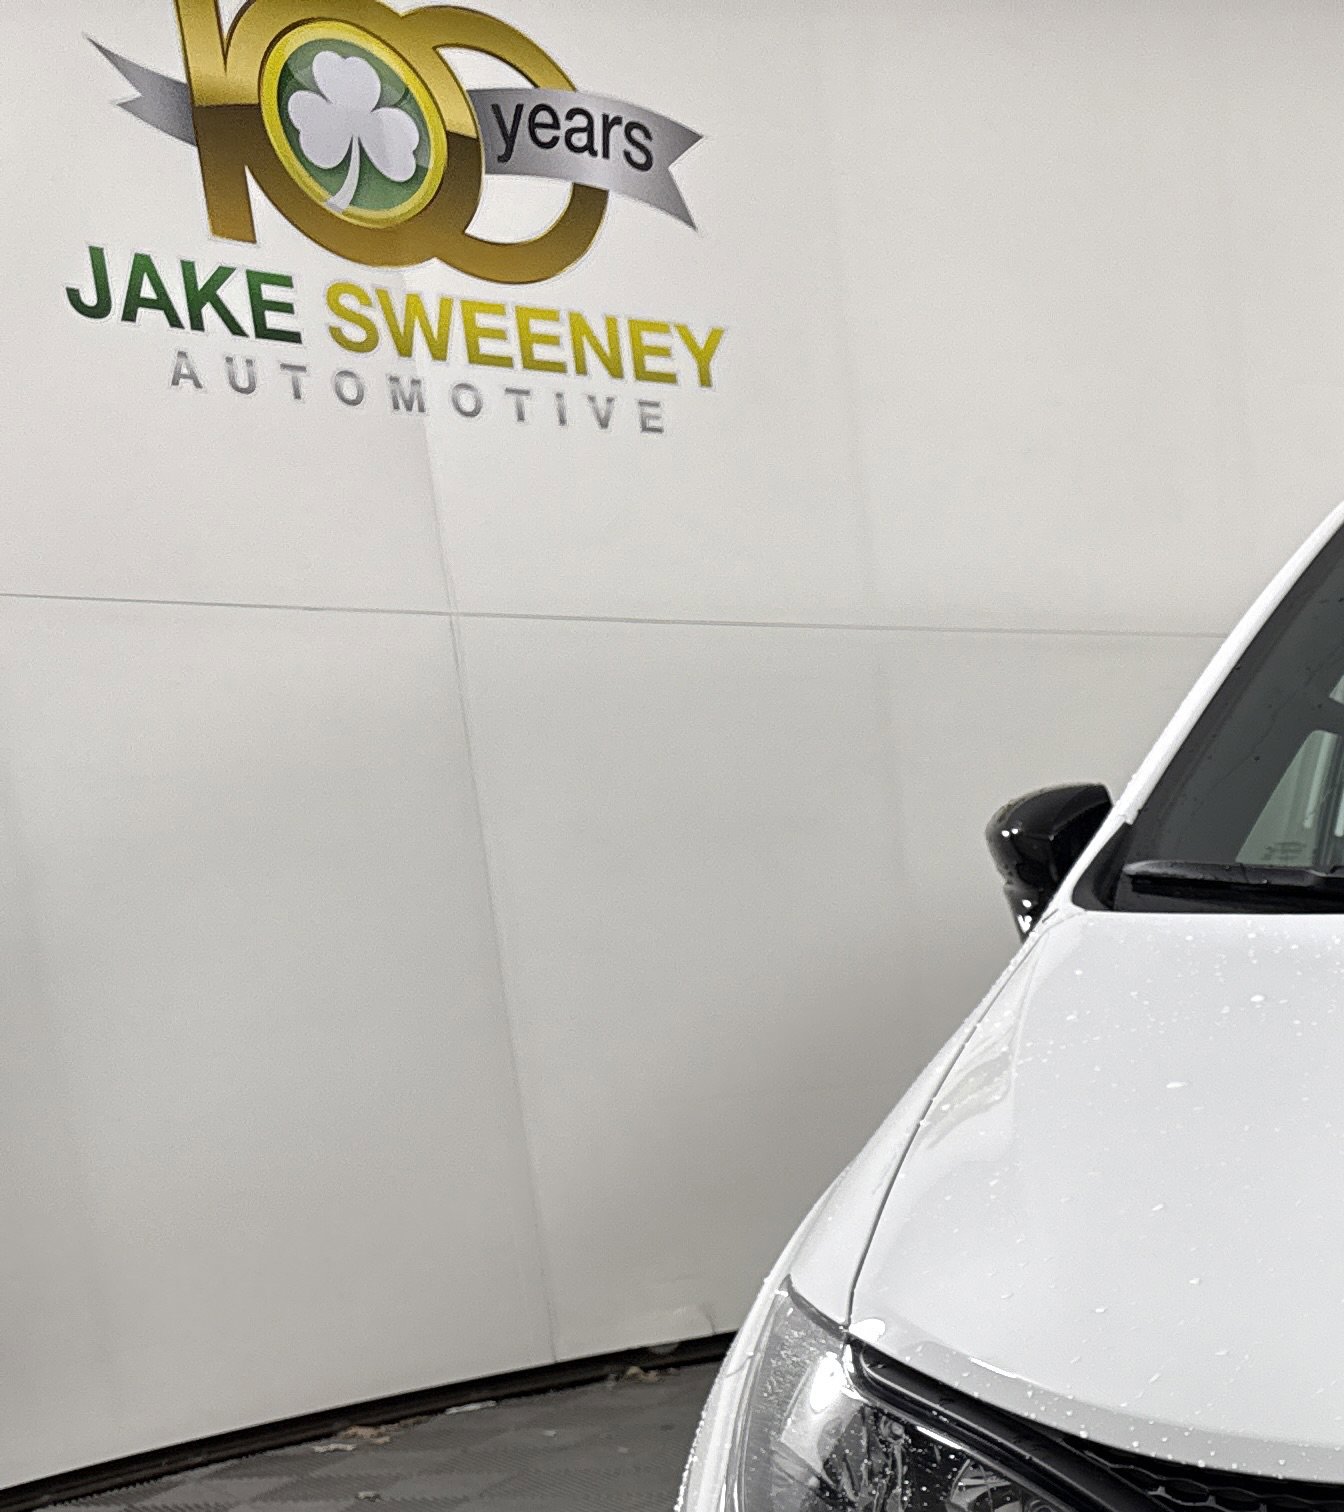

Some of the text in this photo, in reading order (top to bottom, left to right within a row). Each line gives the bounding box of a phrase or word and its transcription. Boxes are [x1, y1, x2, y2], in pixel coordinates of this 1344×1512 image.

[174, 0, 655, 284] 100 years
[65, 245, 725, 389] JAKE SWEENEY
[170, 350, 665, 434] AUTOMOTIVE
